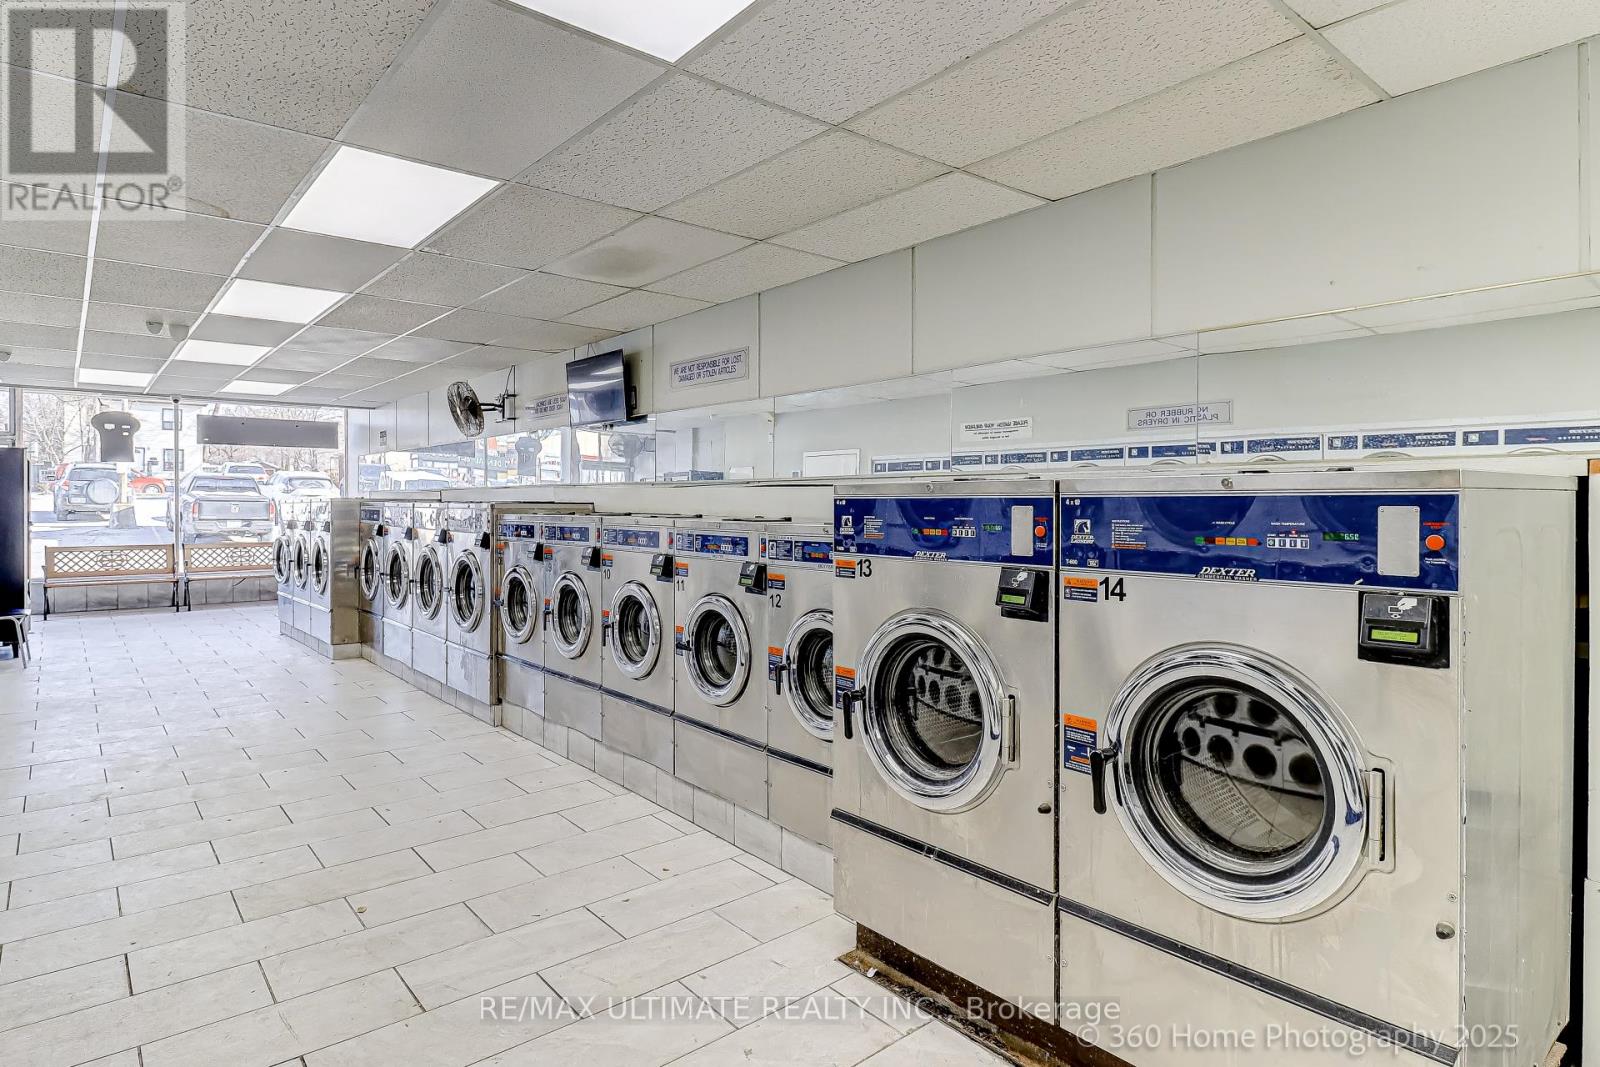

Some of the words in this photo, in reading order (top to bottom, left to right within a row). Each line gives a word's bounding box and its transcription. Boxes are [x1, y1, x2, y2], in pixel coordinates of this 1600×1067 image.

[687, 363, 696, 373] NOT
[696, 359, 721, 371] RESPONSIBLE
[722, 357, 730, 366] FOR
[678, 372, 696, 383] DAMAGED
[696, 371, 702, 380] OR
[702, 368, 717, 379] STOLEN
[717, 365, 737, 376] ARTICLES
[915, 550, 947, 559] DEXTER
[602, 568, 611, 580] 10
[856, 558, 873, 578] 13
[1199, 566, 1256, 577] DEXTER
[676, 579, 685, 592] 11
[1099, 576, 1127, 602] 14
[769, 593, 782, 609] 12
